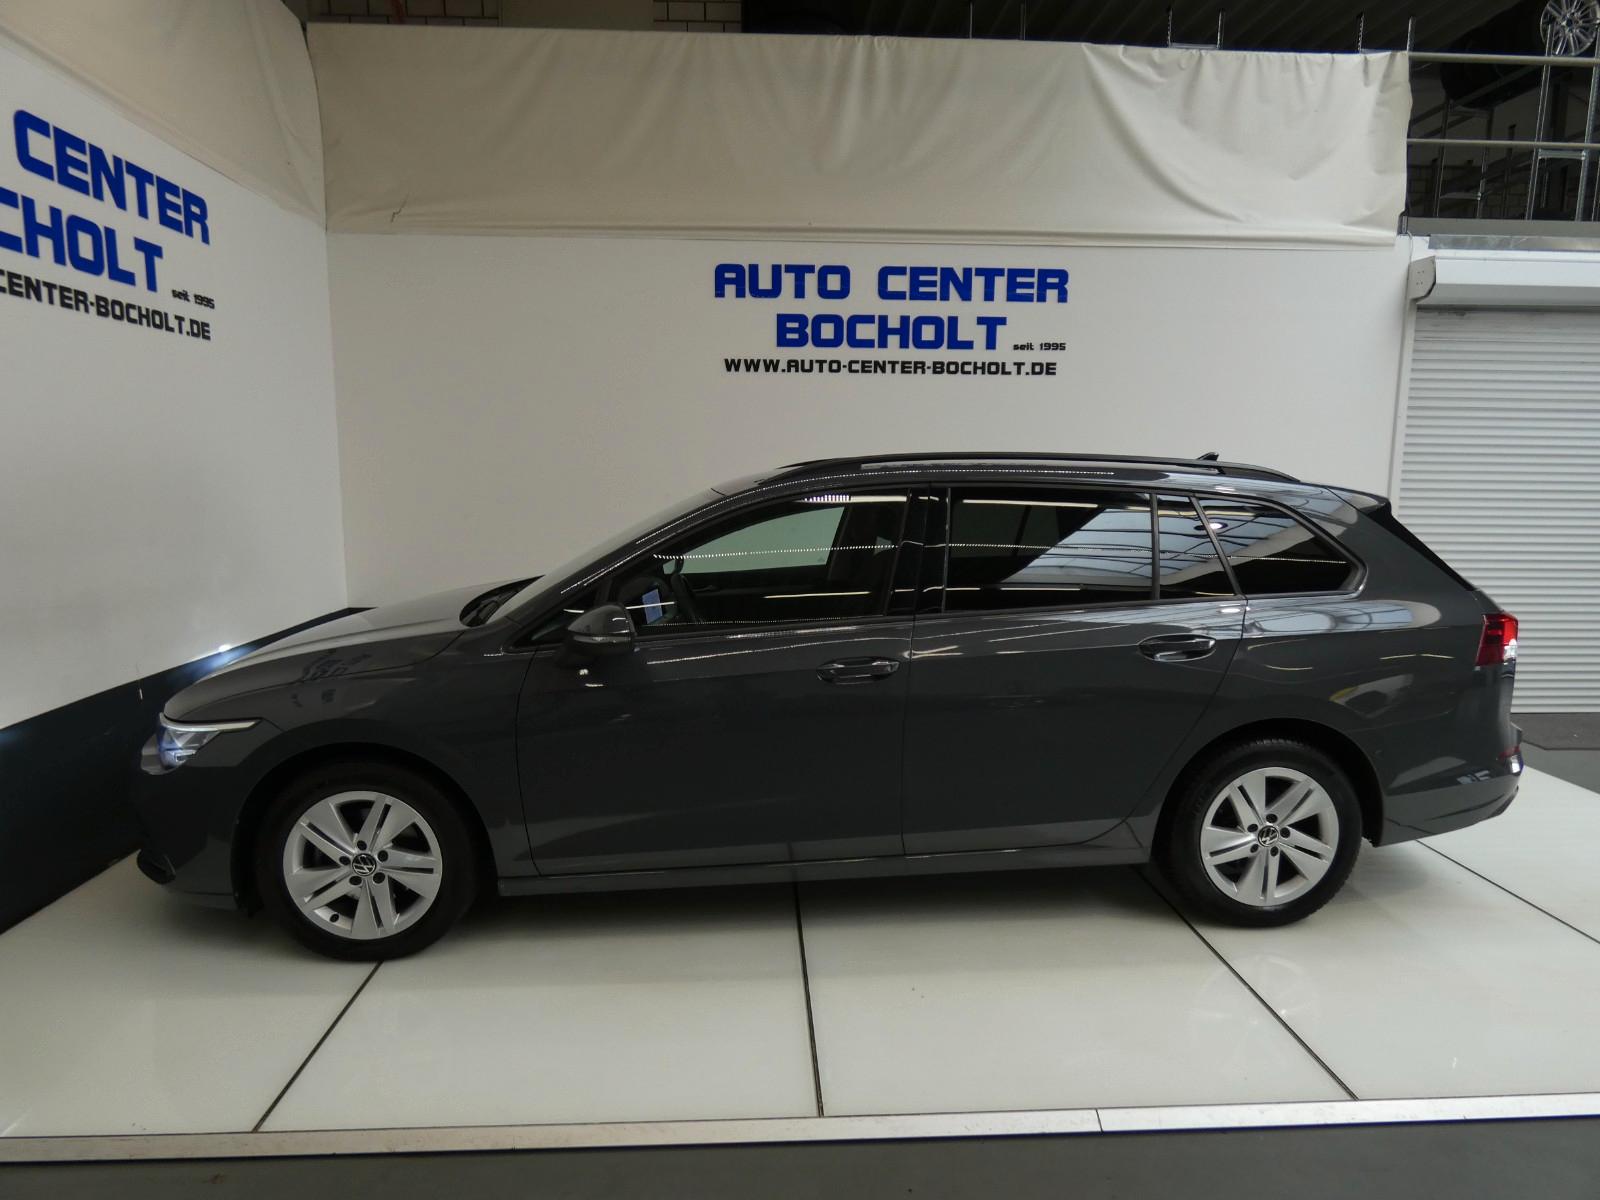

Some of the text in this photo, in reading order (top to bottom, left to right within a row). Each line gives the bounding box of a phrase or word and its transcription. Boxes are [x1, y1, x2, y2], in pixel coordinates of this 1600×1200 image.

[14, 109, 210, 245] CENTER
[714, 263, 1069, 303] AUTO CENTER
[193, 293, 216, 310] 1995
[776, 313, 1007, 350] BOCHOLT
[1013, 342, 1067, 351] seit 1995
[724, 358, 1057, 376] WWW.AUTO-CENTER-BOCHOLT.DE
